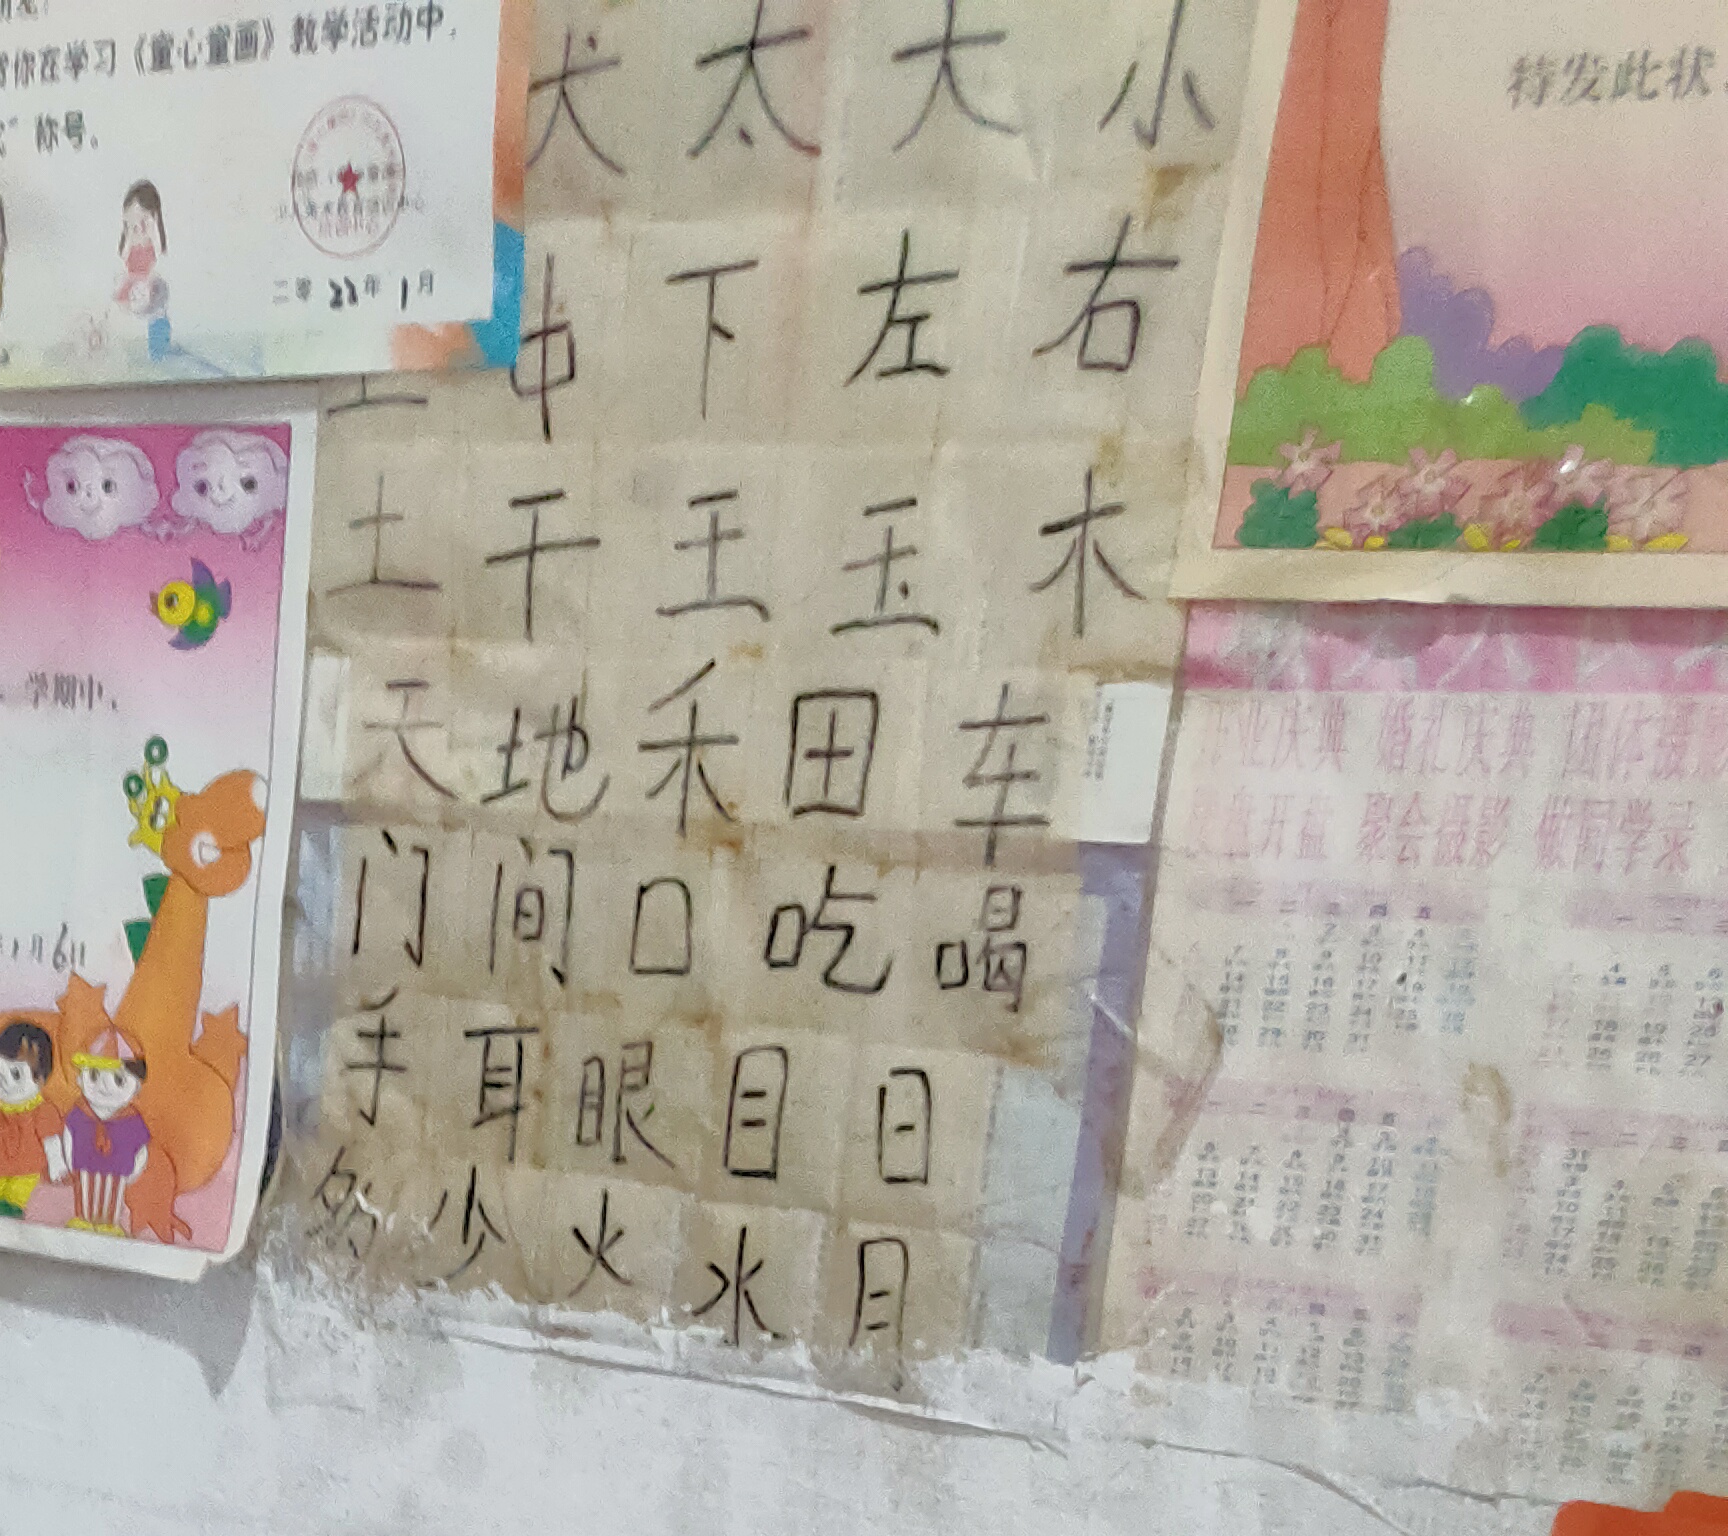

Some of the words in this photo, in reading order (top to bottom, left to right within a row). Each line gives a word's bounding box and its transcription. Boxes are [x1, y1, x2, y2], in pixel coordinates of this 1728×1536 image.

[689, 0, 822, 159] 太
[891, 0, 1021, 153] 大
[1099, 0, 1214, 149] 小
[665, 260, 760, 420] 下
[845, 228, 959, 387] 左
[1032, 214, 1179, 375] 右
[486, 490, 600, 642] 干
[656, 490, 771, 622] 王
[831, 496, 940, 636] 玉
[1028, 469, 1146, 637] 木
[365, 677, 459, 803] 天
[482, 694, 610, 823] 地
[638, 658, 739, 837] 禾
[786, 689, 880, 816] 田
[956, 681, 1049, 867] 车
[351, 830, 429, 968] 门
[488, 837, 574, 985] 间
[631, 876, 691, 975] 口
[765, 865, 896, 995] 吃
[935, 885, 1028, 1012] 喝
[343, 988, 407, 1129] 手
[463, 1027, 539, 1160] 耳
[578, 1041, 674, 1167] 眼
[724, 1045, 787, 1179] 目
[877, 1069, 932, 1186] 日
[569, 1188, 633, 1298] 火
[693, 1225, 781, 1346] 水
[848, 1236, 911, 1390] 月
